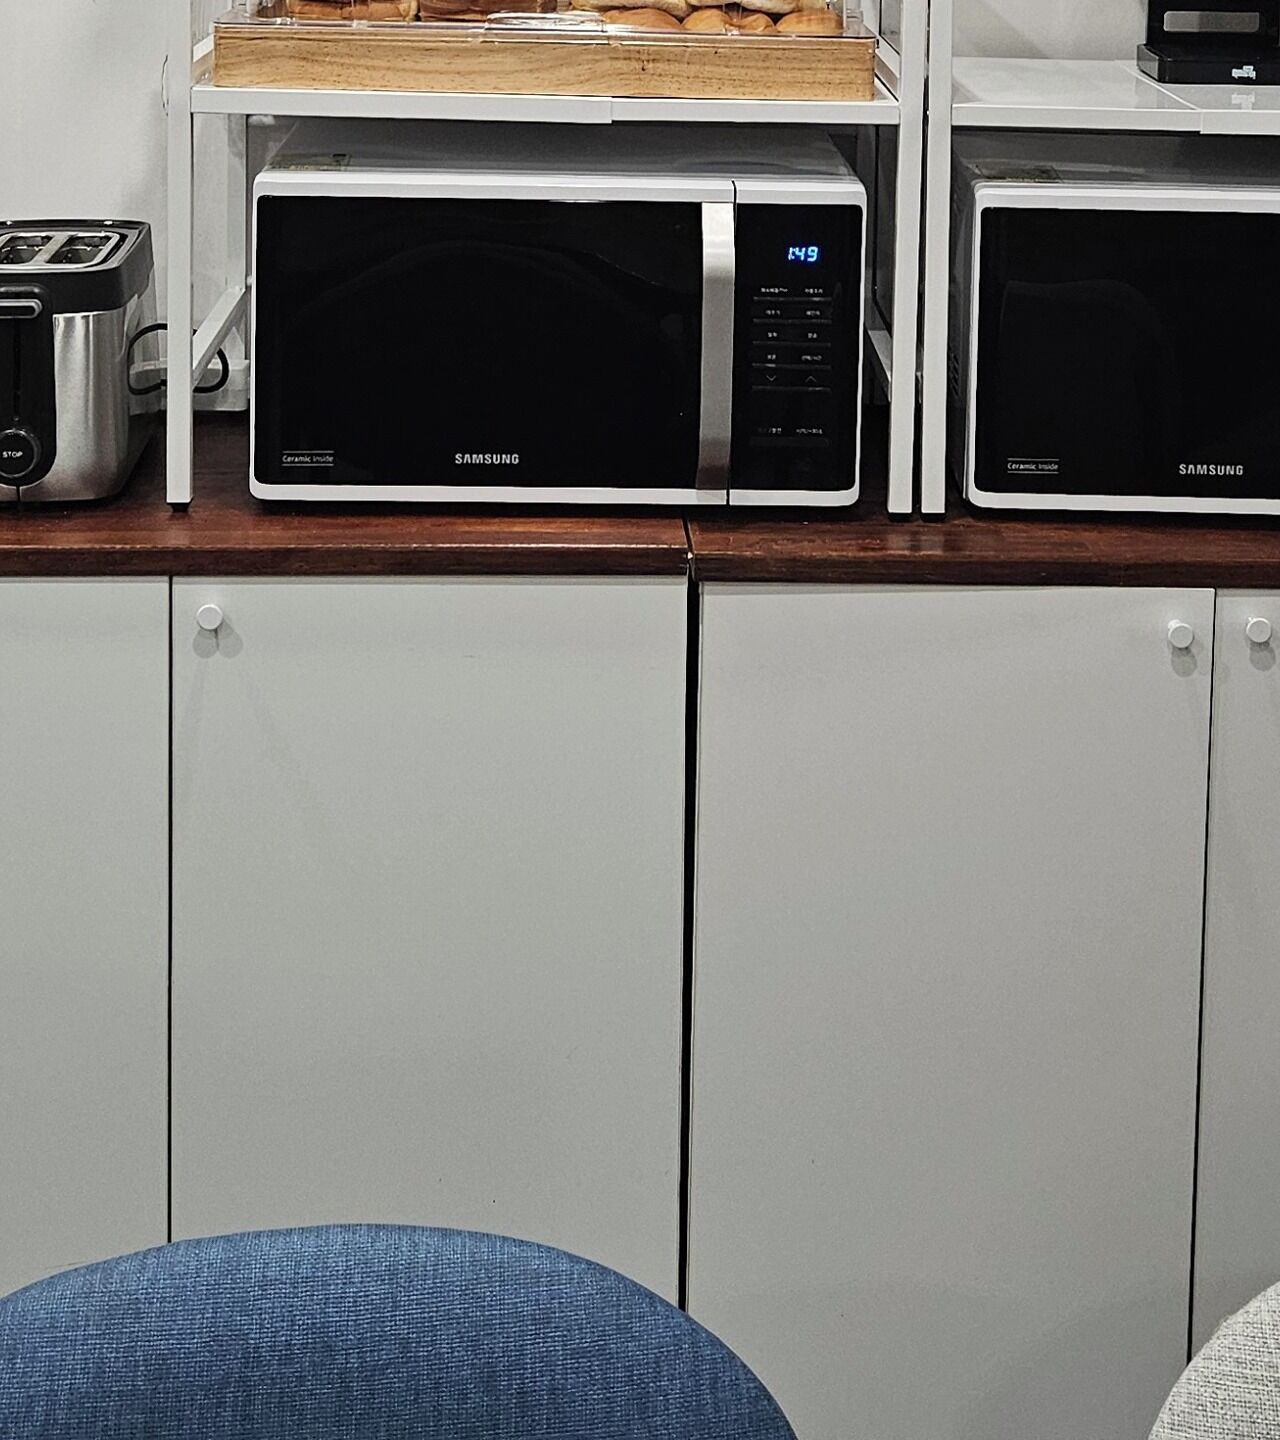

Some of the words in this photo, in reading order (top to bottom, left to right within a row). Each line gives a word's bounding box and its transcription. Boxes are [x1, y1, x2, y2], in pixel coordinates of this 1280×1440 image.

[282, 455, 311, 464] Ceramic
[455, 453, 520, 465] SAMSUNG
[1007, 462, 1037, 471] Ceramic
[1178, 463, 1244, 476] SAMSUNG
